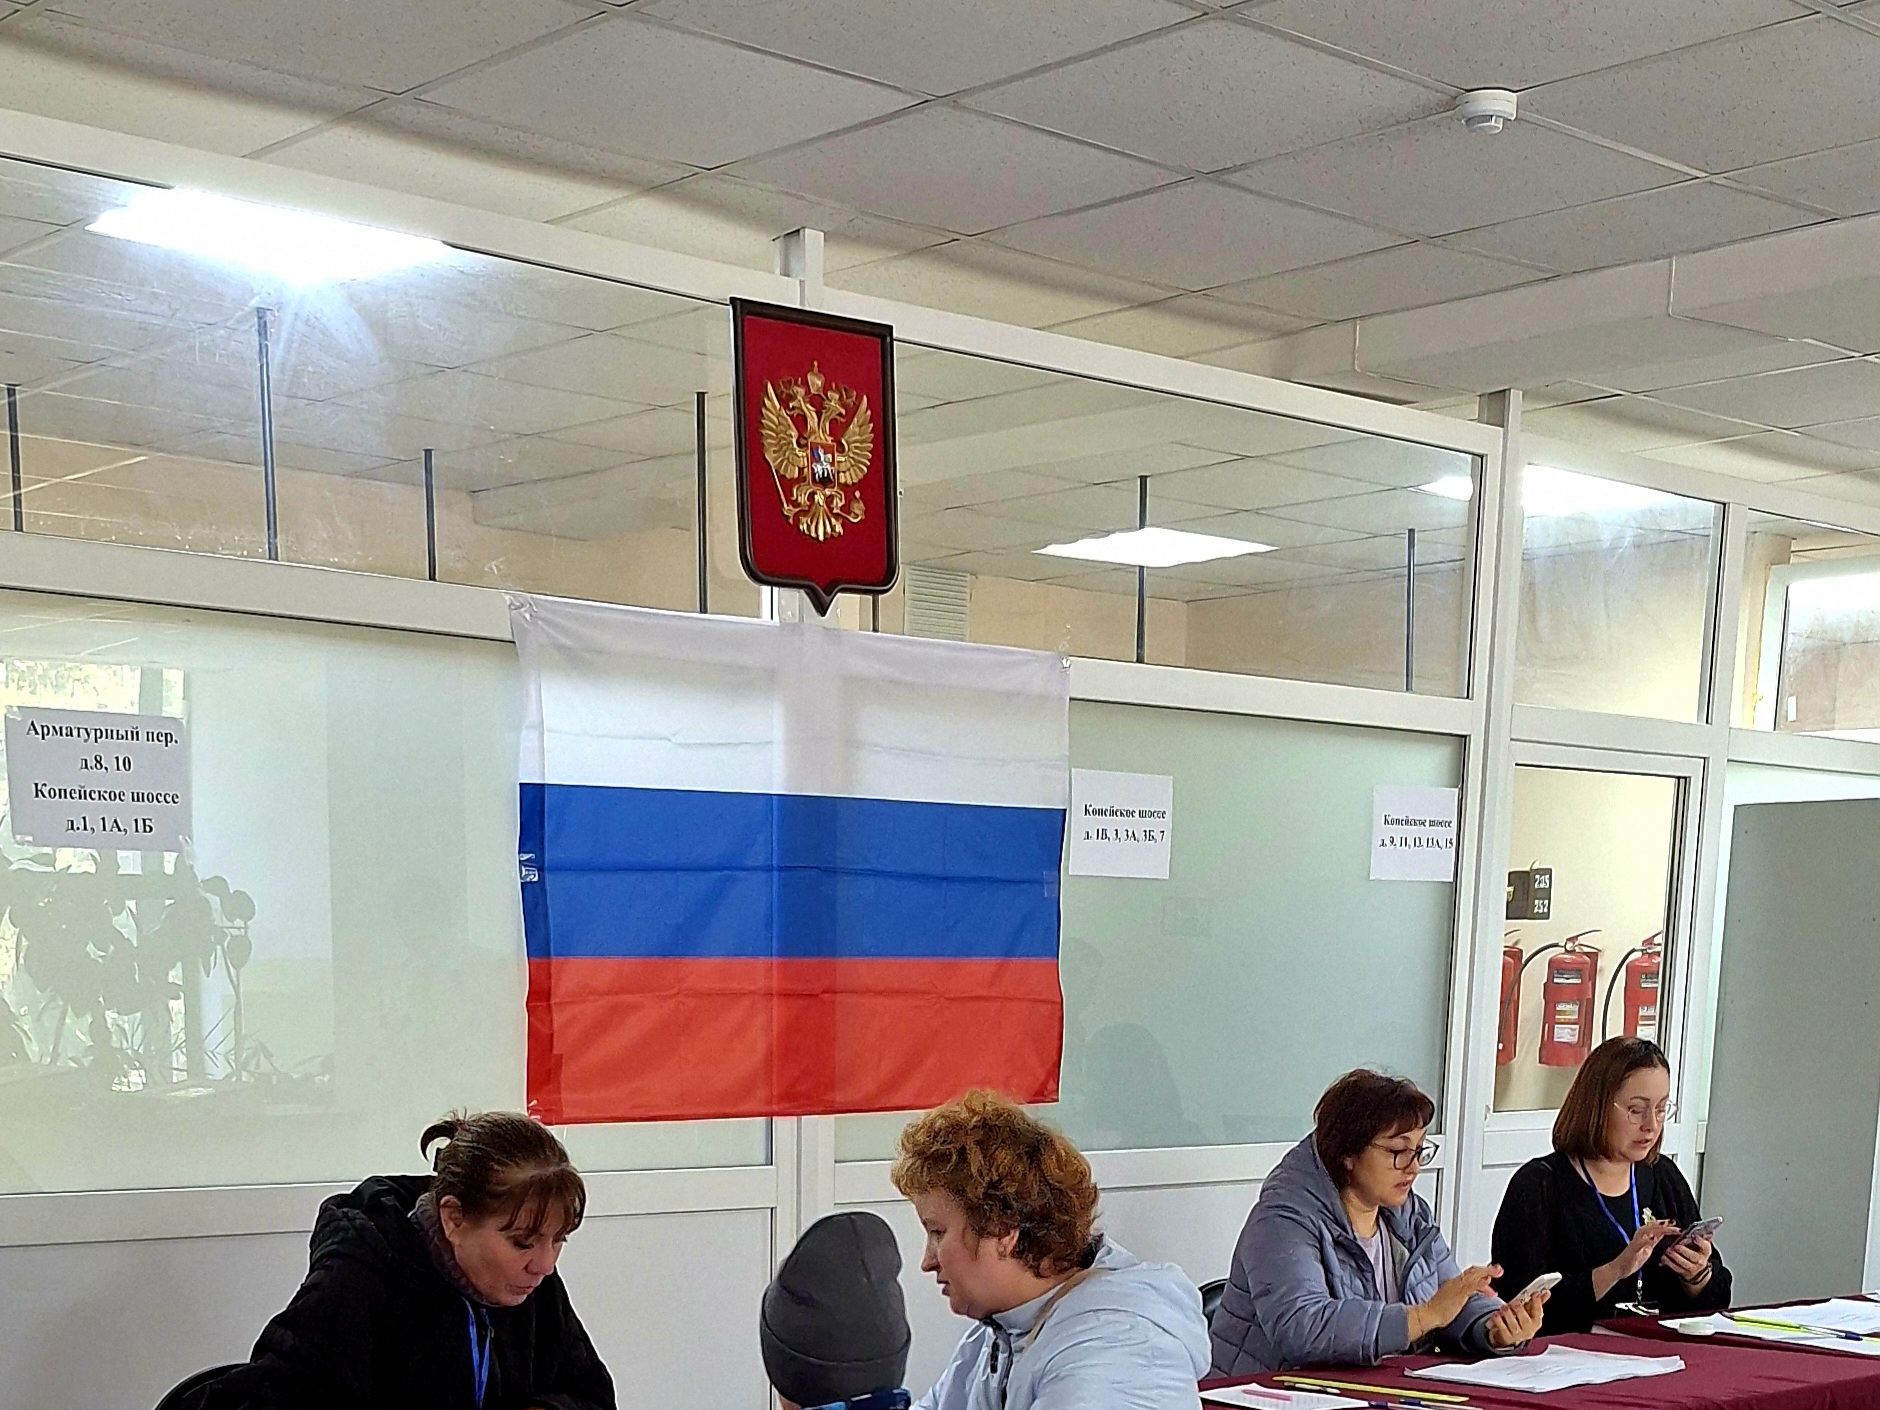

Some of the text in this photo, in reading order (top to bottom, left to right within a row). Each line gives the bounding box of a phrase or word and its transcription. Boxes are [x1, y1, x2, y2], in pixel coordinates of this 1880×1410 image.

[26, 720, 179, 747] Арматурный пер.
[80, 754, 132, 773] д.8, 10
[33, 782, 180, 805] Копейское шоссе
[1084, 804, 1166, 819] Копейское шоссе
[1384, 814, 1452, 828] Копейское шоссе
[65, 816, 154, 835] д.1, 1А, 1Б
[1124, 829, 1140, 843] 3А,
[1159, 830, 1165, 842] 7
